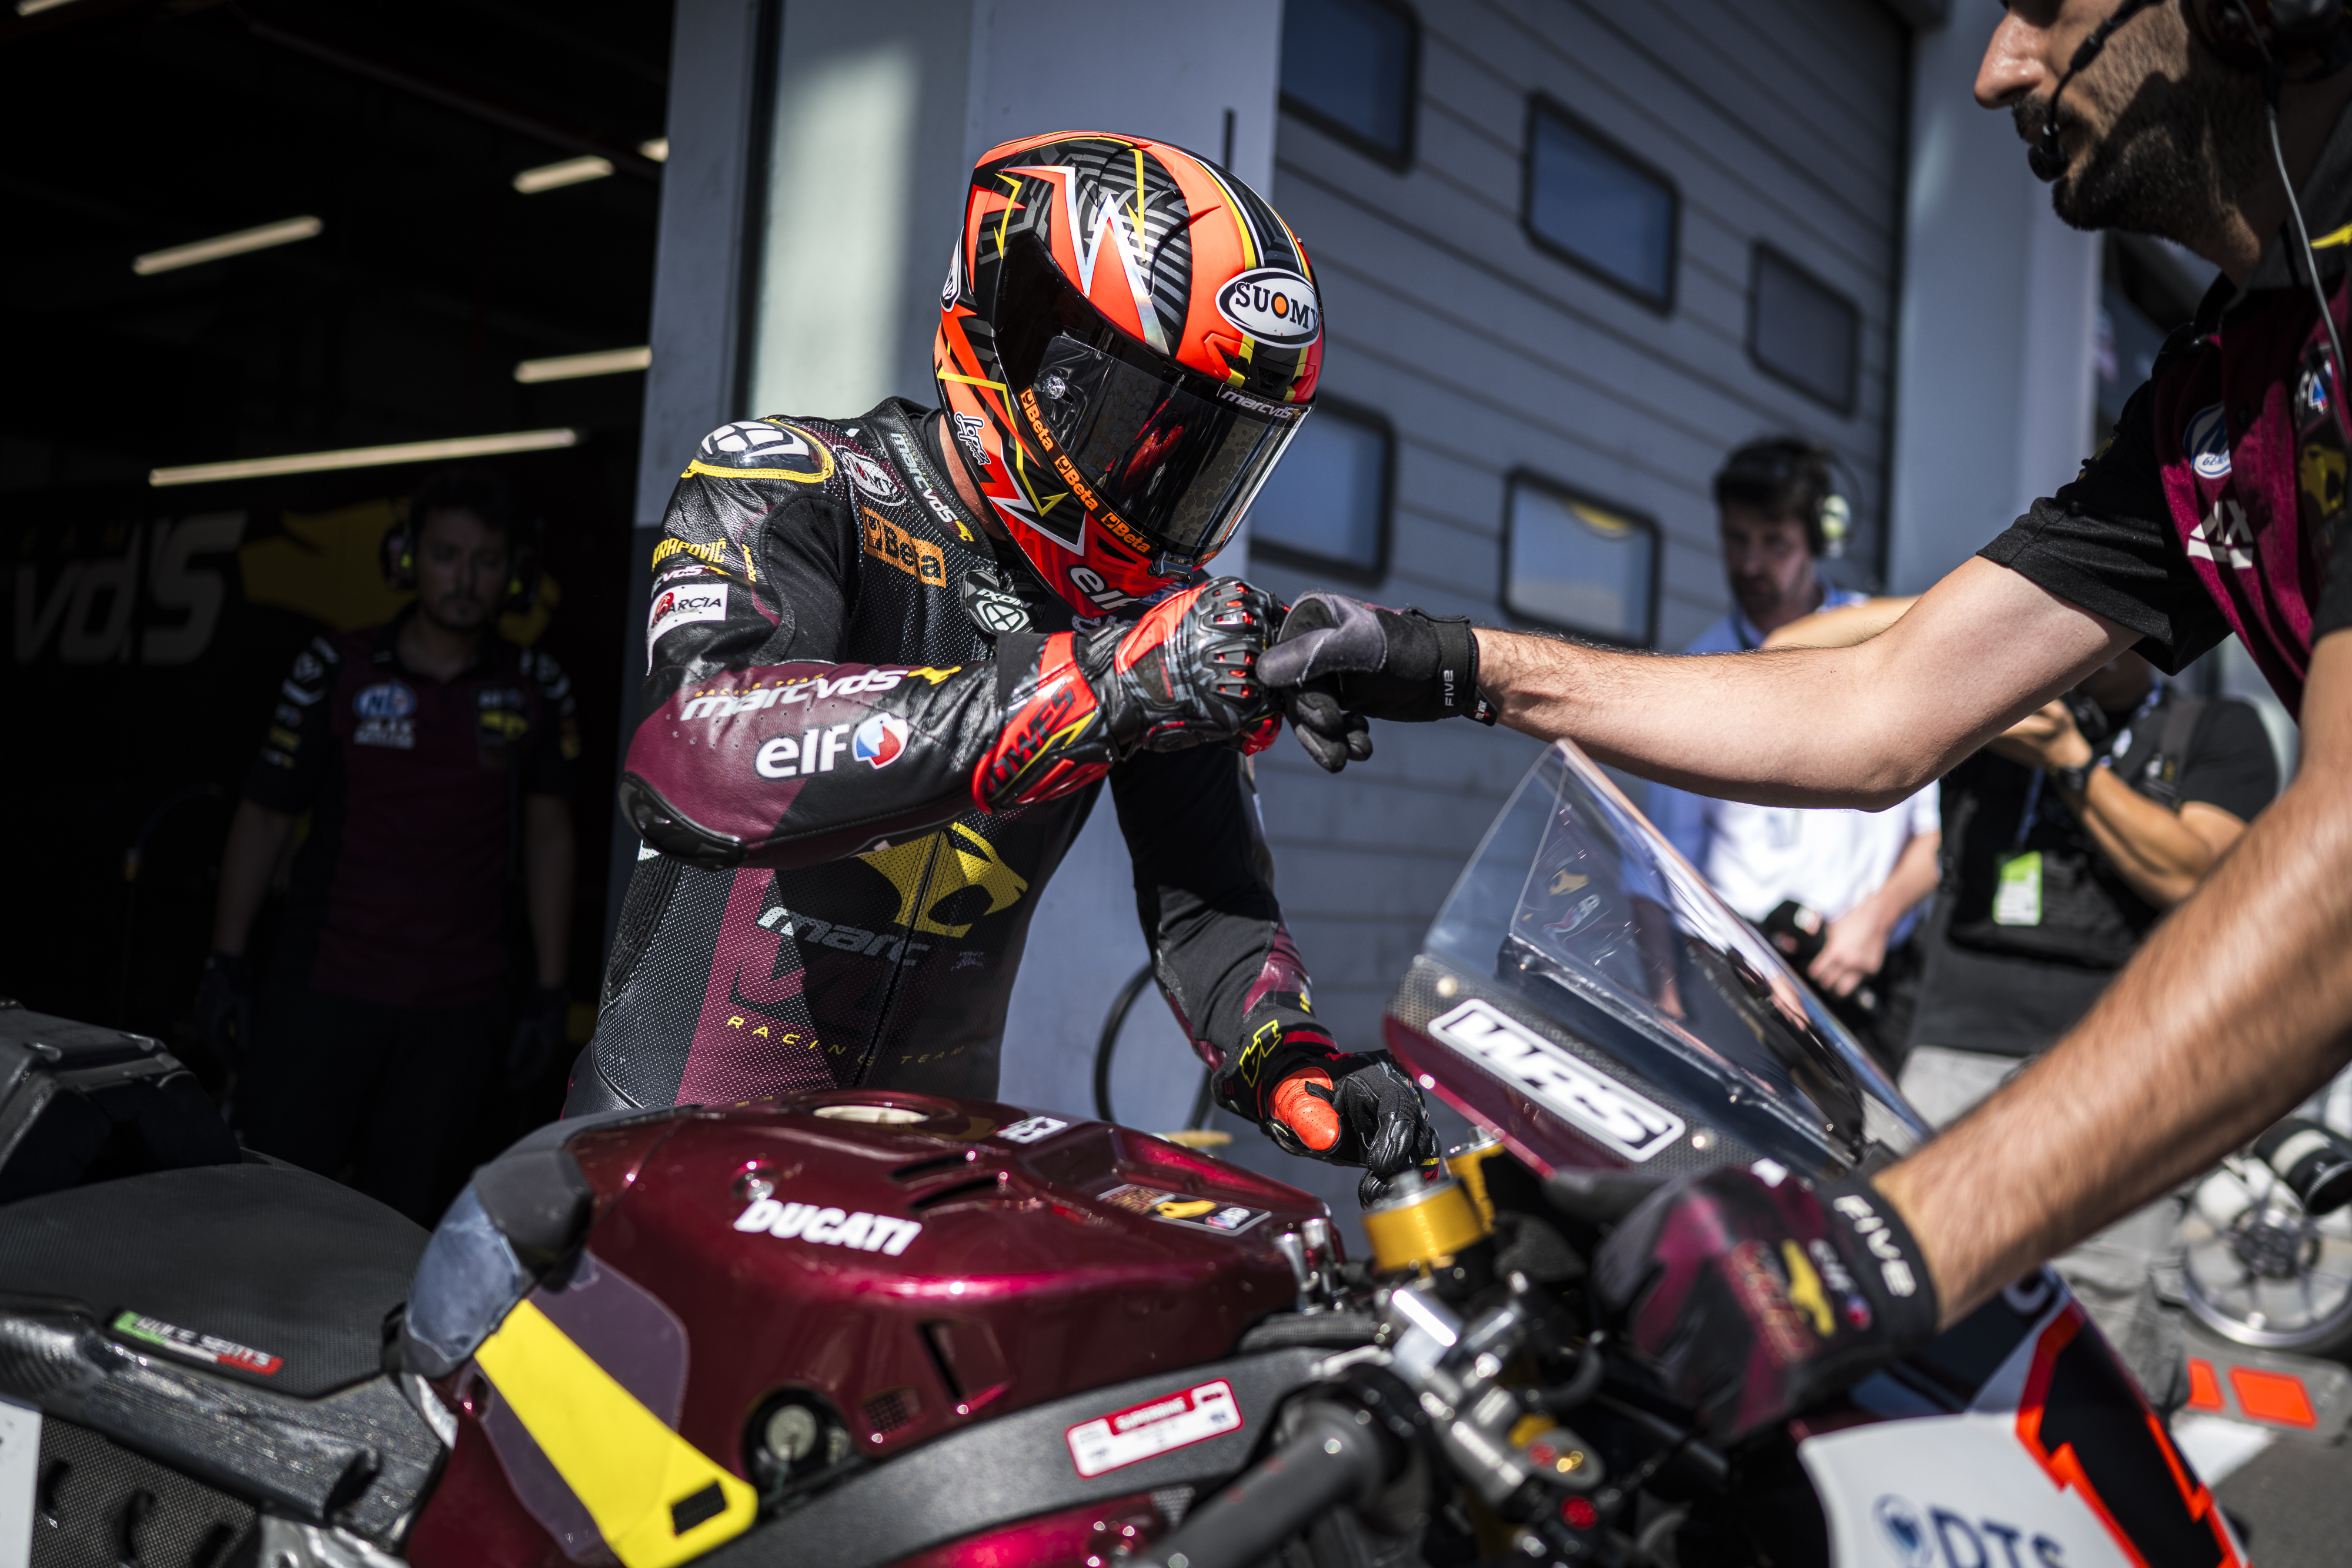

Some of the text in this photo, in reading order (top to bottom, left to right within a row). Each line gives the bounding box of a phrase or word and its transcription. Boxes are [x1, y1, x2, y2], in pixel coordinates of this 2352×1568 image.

[1235, 282, 1318, 336] SUOMY
[1025, 403, 1054, 452] Beta
[1063, 467, 1098, 511] Beta
[1111, 519, 1151, 553] Beta
[977, 589, 1033, 609] IXON
[756, 723, 850, 778] elf
[756, 907, 931, 966] marc
[727, 1016, 874, 1066] RACING
[734, 1198, 923, 1256] DUCATI
